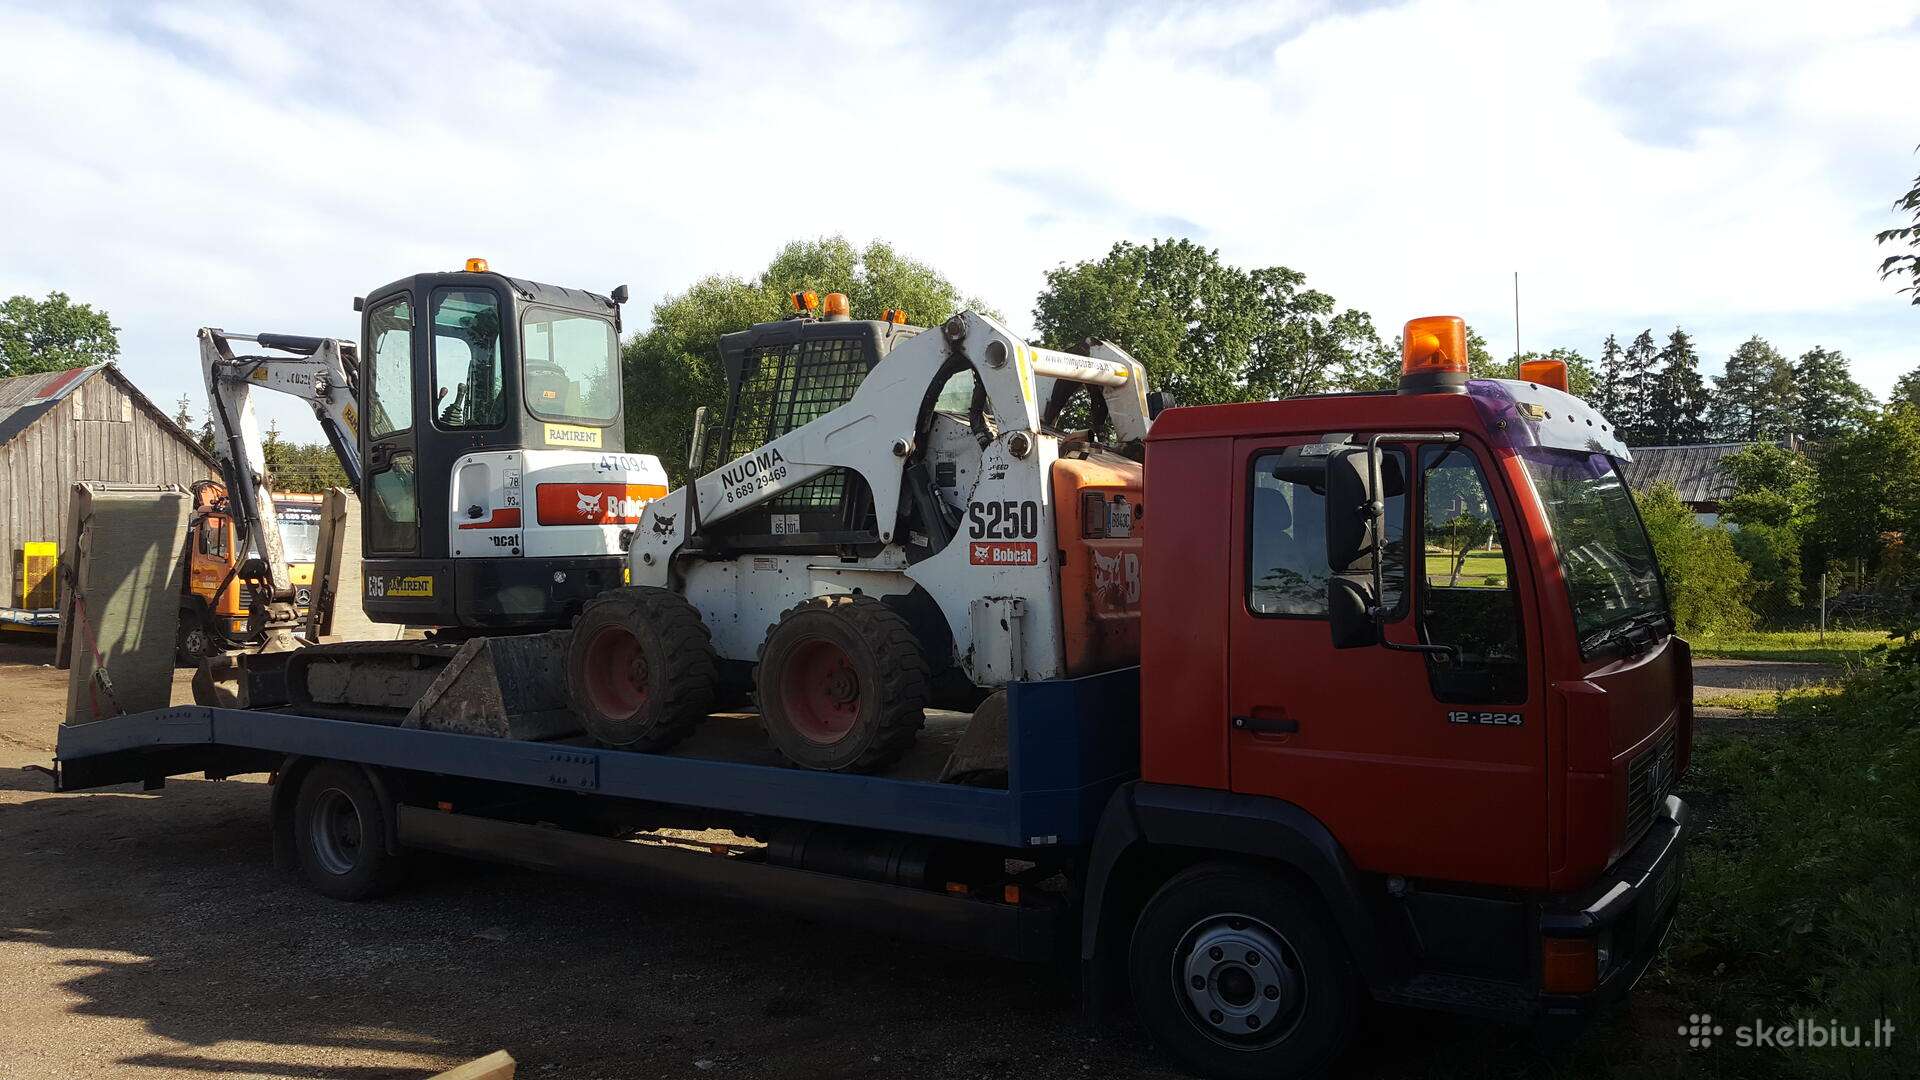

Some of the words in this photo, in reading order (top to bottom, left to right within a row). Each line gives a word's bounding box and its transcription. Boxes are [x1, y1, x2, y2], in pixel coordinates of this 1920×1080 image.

[549, 429, 597, 443] RAMIRENT
[600, 455, 648, 472] 47094
[721, 448, 783, 490] NUOMA
[509, 477, 519, 487] 78
[727, 492, 734, 503] 8
[735, 482, 754, 499] 689
[755, 466, 787, 489] 29469
[507, 496, 516, 506] 93
[969, 500, 1038, 540] S250
[993, 547, 1032, 562] Bobcat
[368, 576, 384, 597] E35
